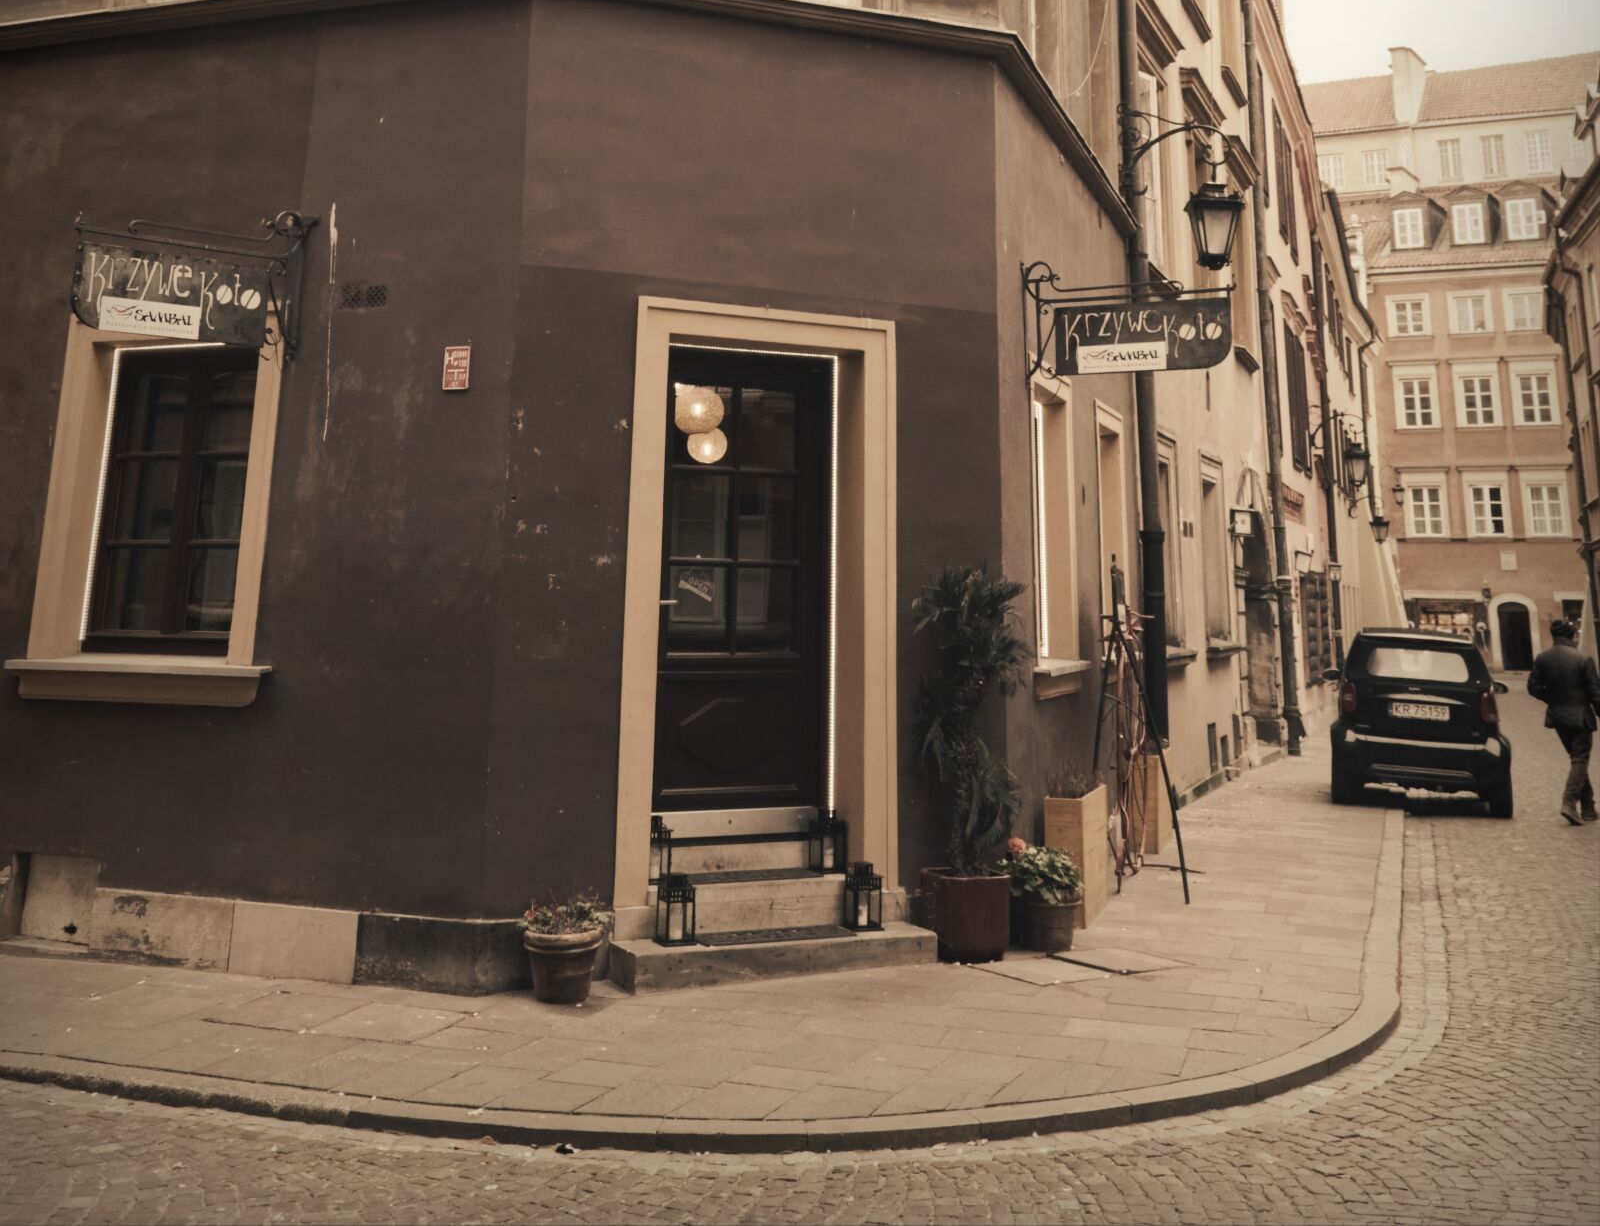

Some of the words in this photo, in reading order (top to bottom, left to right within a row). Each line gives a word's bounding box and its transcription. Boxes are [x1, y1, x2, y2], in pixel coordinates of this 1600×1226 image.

[134, 309, 193, 326] SAMBAL
[689, 577, 709, 593] OPEN
[1394, 704, 1410, 715] KR
